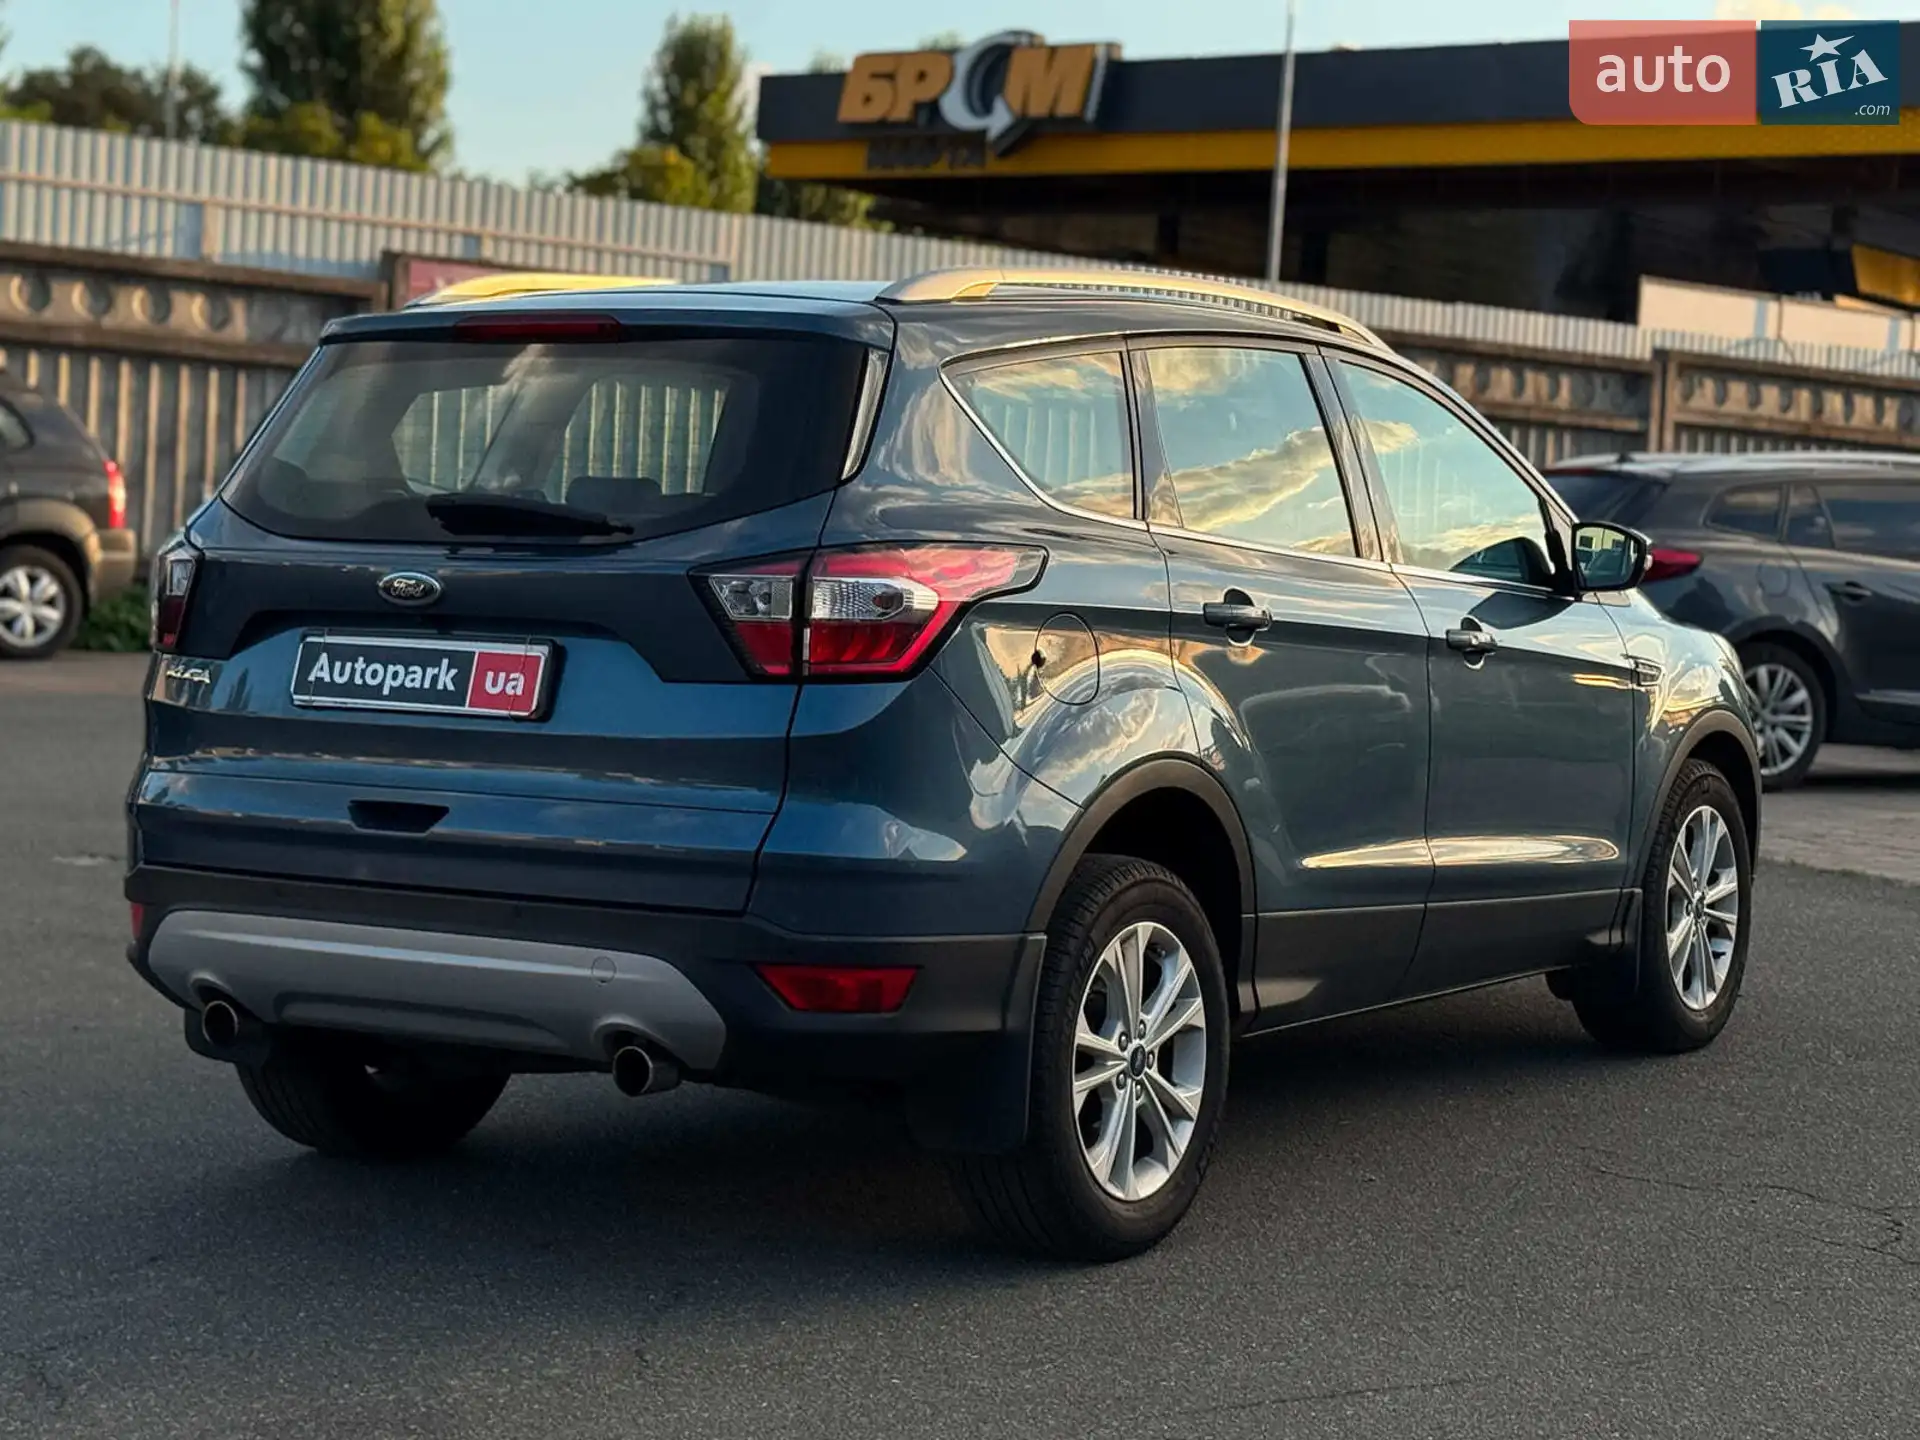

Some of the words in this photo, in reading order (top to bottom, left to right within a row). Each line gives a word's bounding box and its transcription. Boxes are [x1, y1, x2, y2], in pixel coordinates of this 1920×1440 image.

[390, 577, 425, 598] Ford
[307, 652, 458, 695] Autopark
[484, 667, 525, 697] ua
